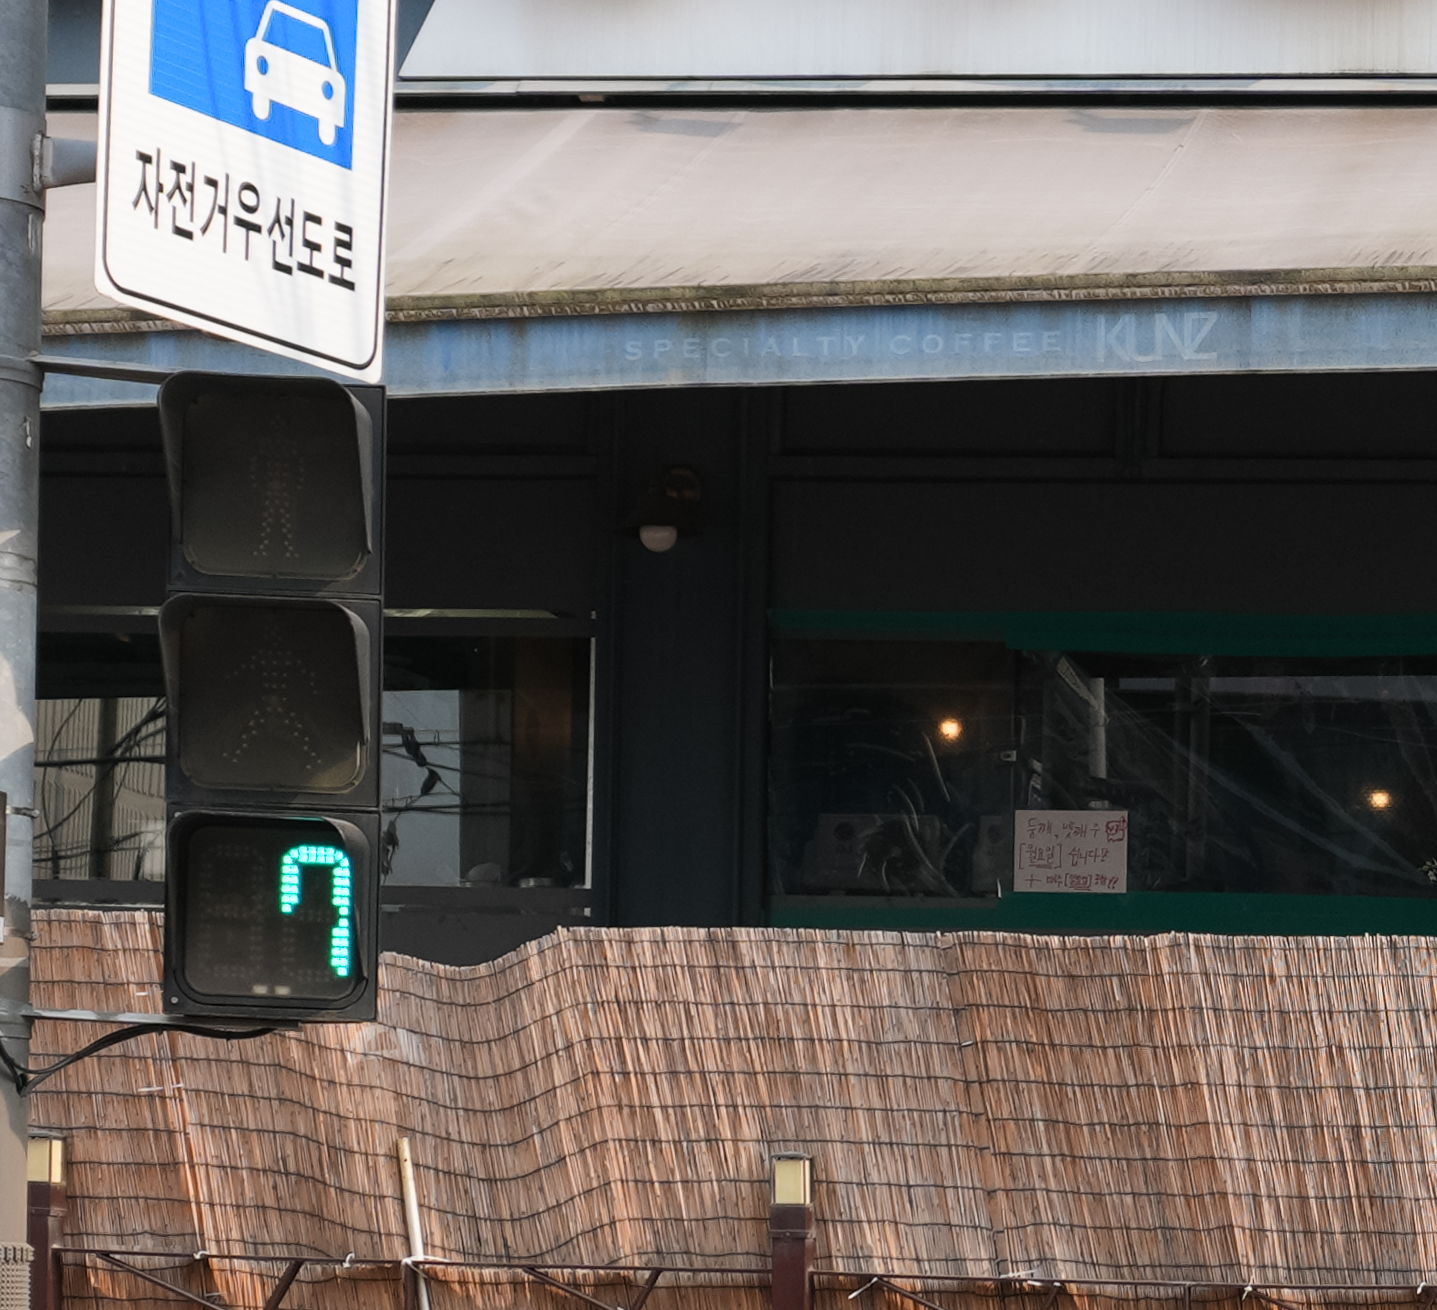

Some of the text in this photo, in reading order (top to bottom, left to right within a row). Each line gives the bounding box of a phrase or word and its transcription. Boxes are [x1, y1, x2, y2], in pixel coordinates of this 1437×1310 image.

[131, 146, 358, 294] 자전거우선도로
[624, 312, 1218, 362] SPECIALTY COFFEE KUNZ
[279, 844, 352, 978] 7
